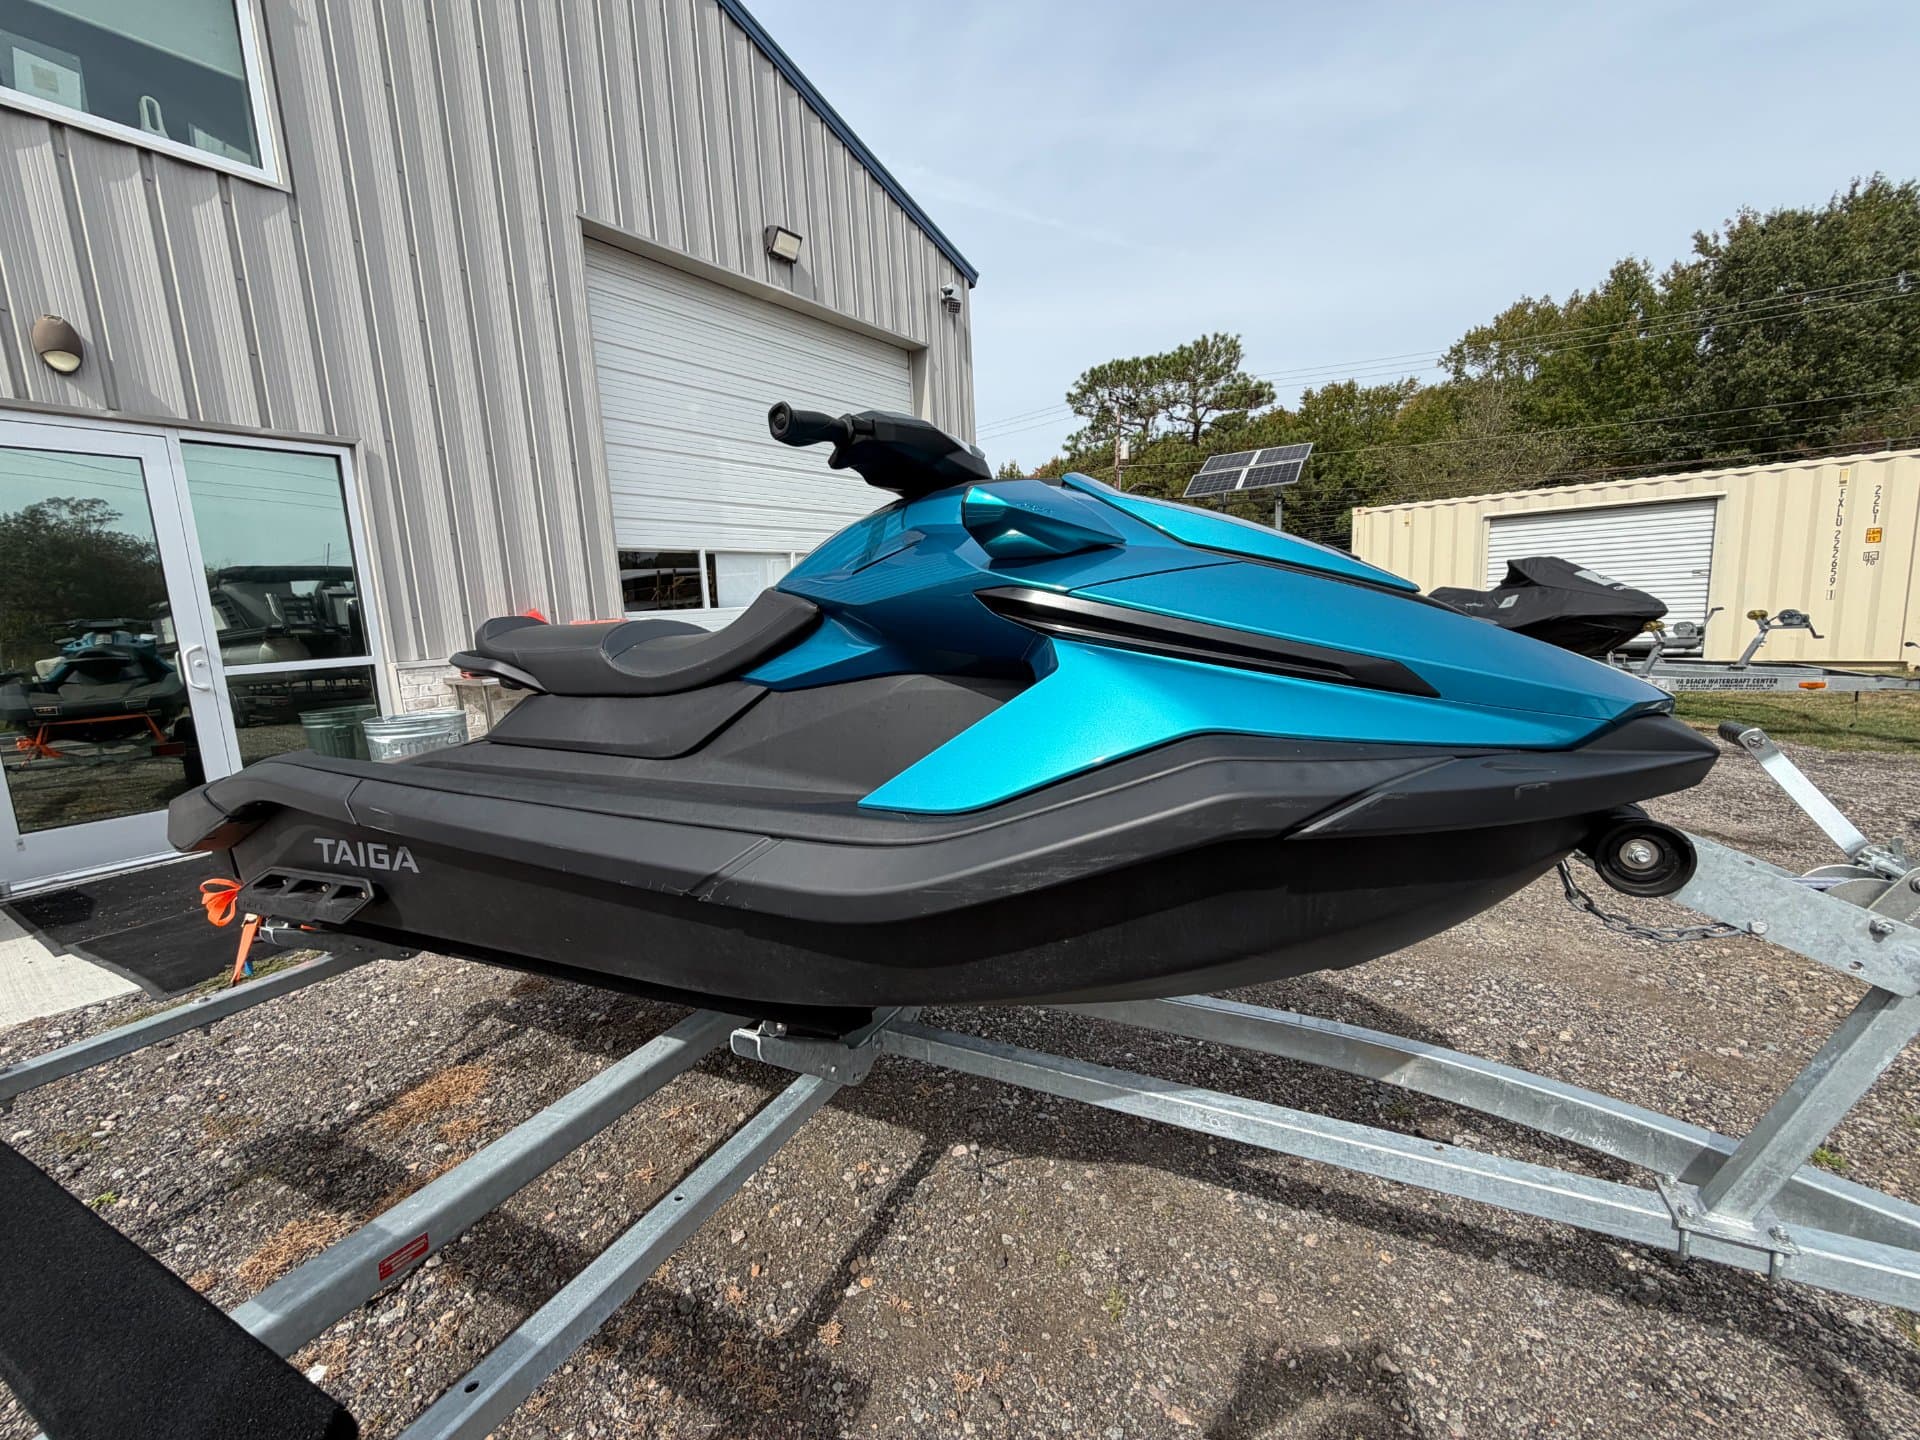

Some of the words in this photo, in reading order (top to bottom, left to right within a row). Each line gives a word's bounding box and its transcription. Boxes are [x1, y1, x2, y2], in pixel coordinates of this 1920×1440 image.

[1836, 488, 1847, 527] FXLU
[1872, 485, 1882, 524] 22G1
[1829, 530, 1841, 586] 222659
[313, 837, 421, 874] TAIGA
